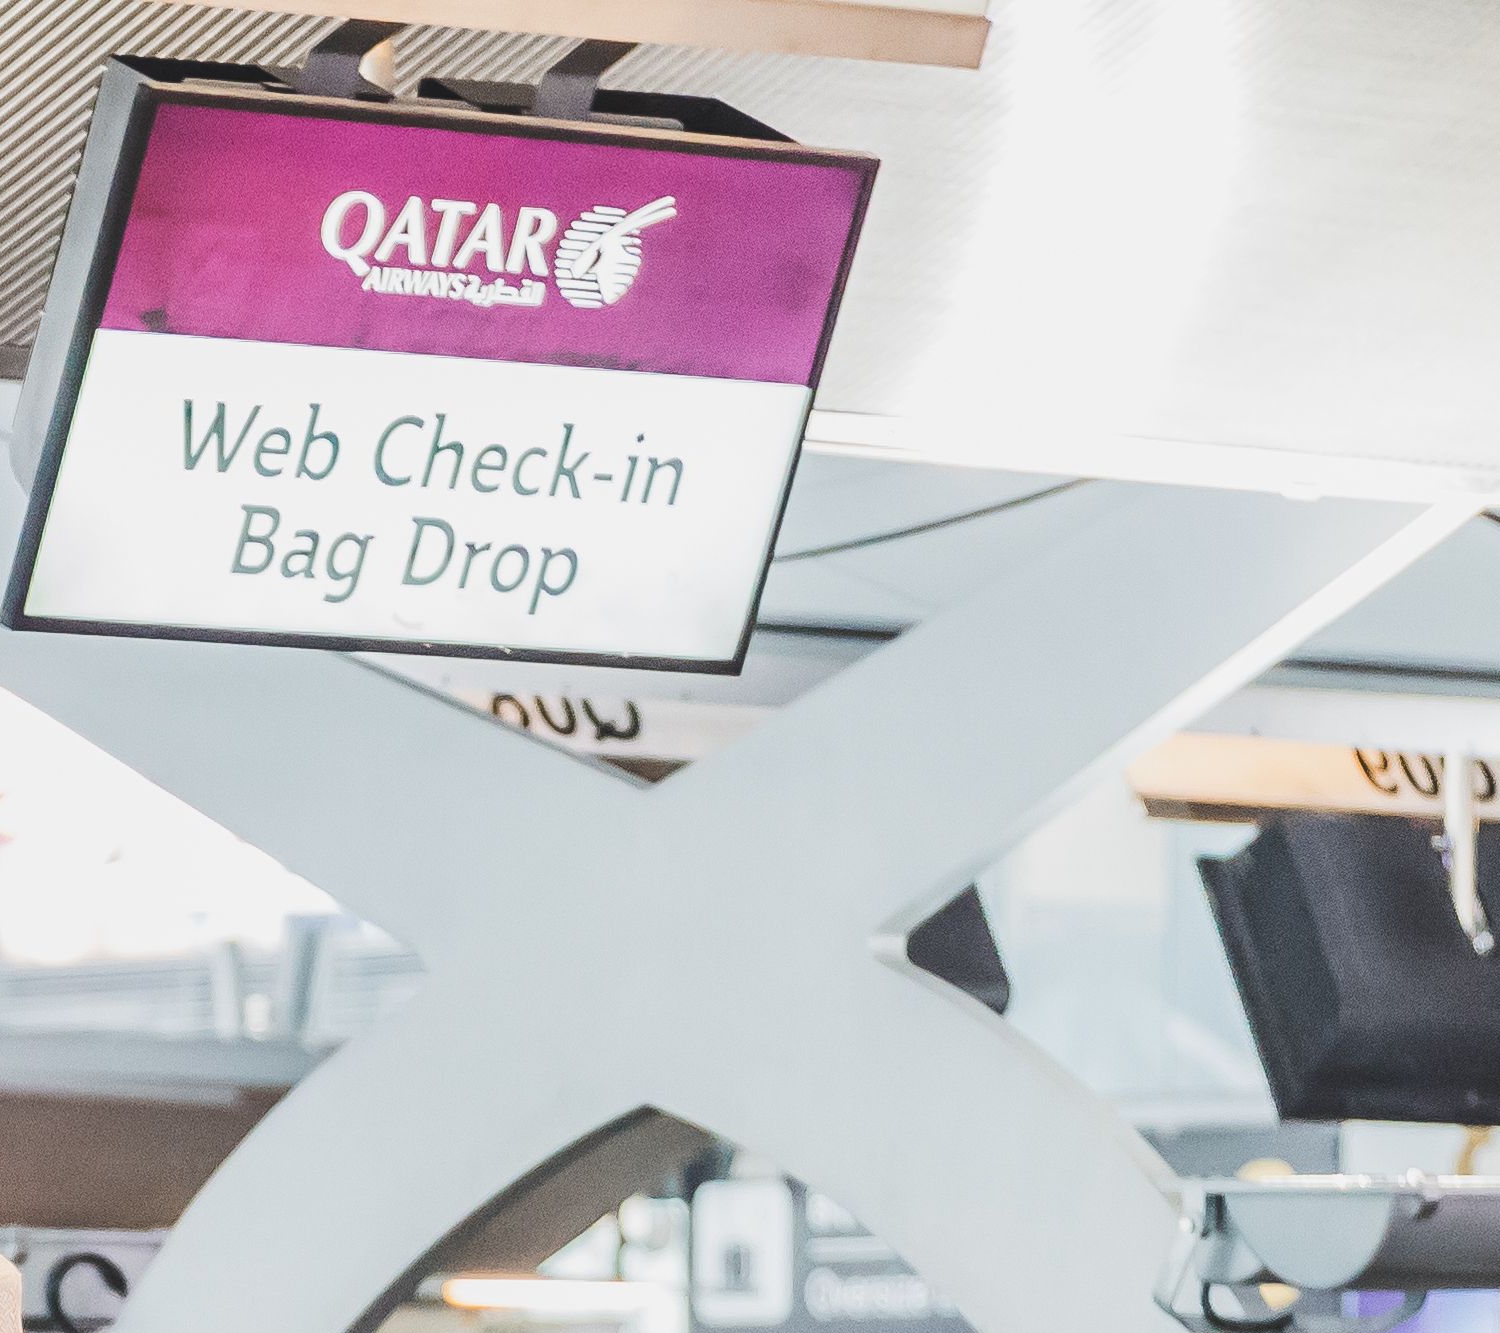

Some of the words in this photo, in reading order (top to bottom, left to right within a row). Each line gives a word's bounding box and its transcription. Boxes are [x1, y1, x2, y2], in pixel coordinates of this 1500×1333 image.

[320, 190, 558, 277] QATAR
[361, 266, 465, 300] AIRWAYS
[183, 398, 341, 481] Web
[373, 412, 684, 506] Check-in
[230, 503, 376, 604] Bag
[401, 516, 579, 616] Drop
